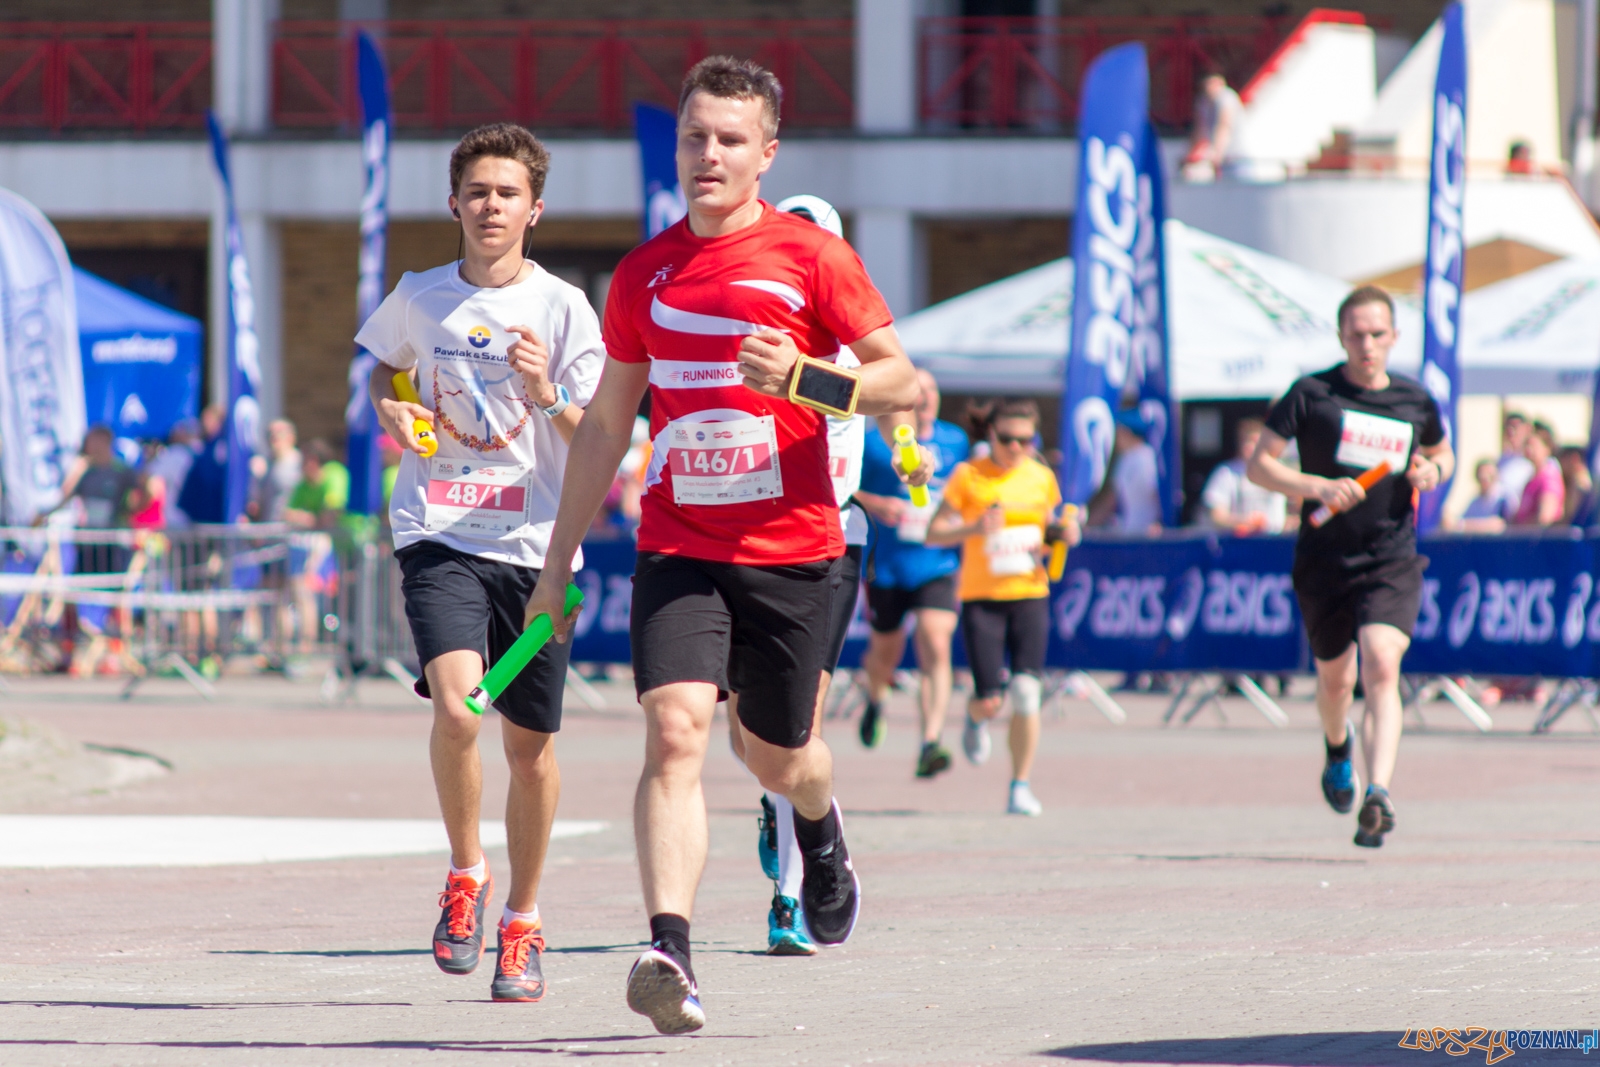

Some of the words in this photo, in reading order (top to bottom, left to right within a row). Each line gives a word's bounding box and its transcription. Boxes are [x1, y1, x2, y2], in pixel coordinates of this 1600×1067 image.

[1082, 136, 1139, 387] asics
[682, 368, 735, 382] RUNNING
[680, 447, 756, 474] 146/1
[446, 483, 503, 507] 48/1
[1091, 574, 1167, 637] asics
[1201, 570, 1293, 635] asics
[1480, 578, 1556, 643] asics
